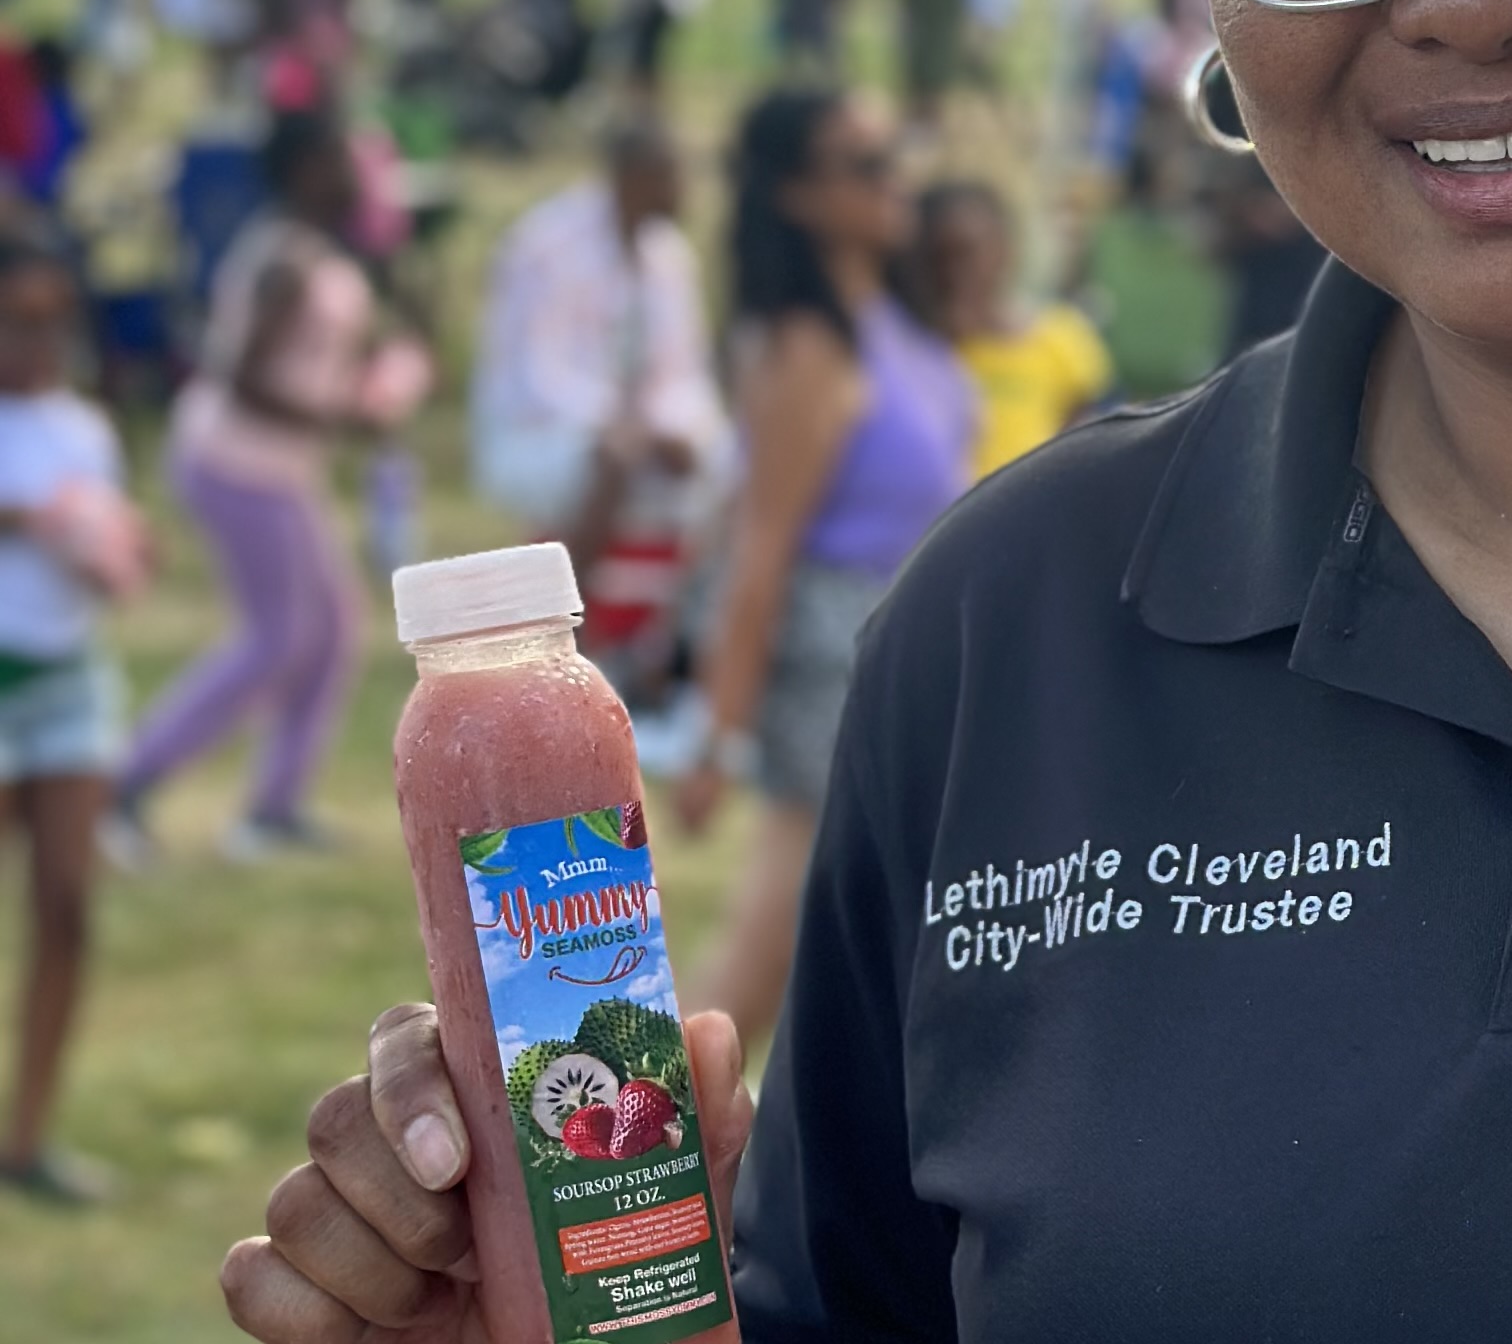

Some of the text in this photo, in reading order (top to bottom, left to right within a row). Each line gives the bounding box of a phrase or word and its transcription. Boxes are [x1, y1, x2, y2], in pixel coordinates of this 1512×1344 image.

[924, 820, 1392, 925] Lethimyle Cleveland
[497, 879, 651, 960] Yummy
[541, 923, 638, 959] SEAMOSS
[945, 887, 1353, 972] City-Wide Trustee
[553, 1151, 700, 1202] SOURSOP STRAWBERRY
[613, 1186, 666, 1211] 12 OZ.
[598, 1252, 701, 1289] Keep Refrigerated
[610, 1267, 697, 1302] Shake well
